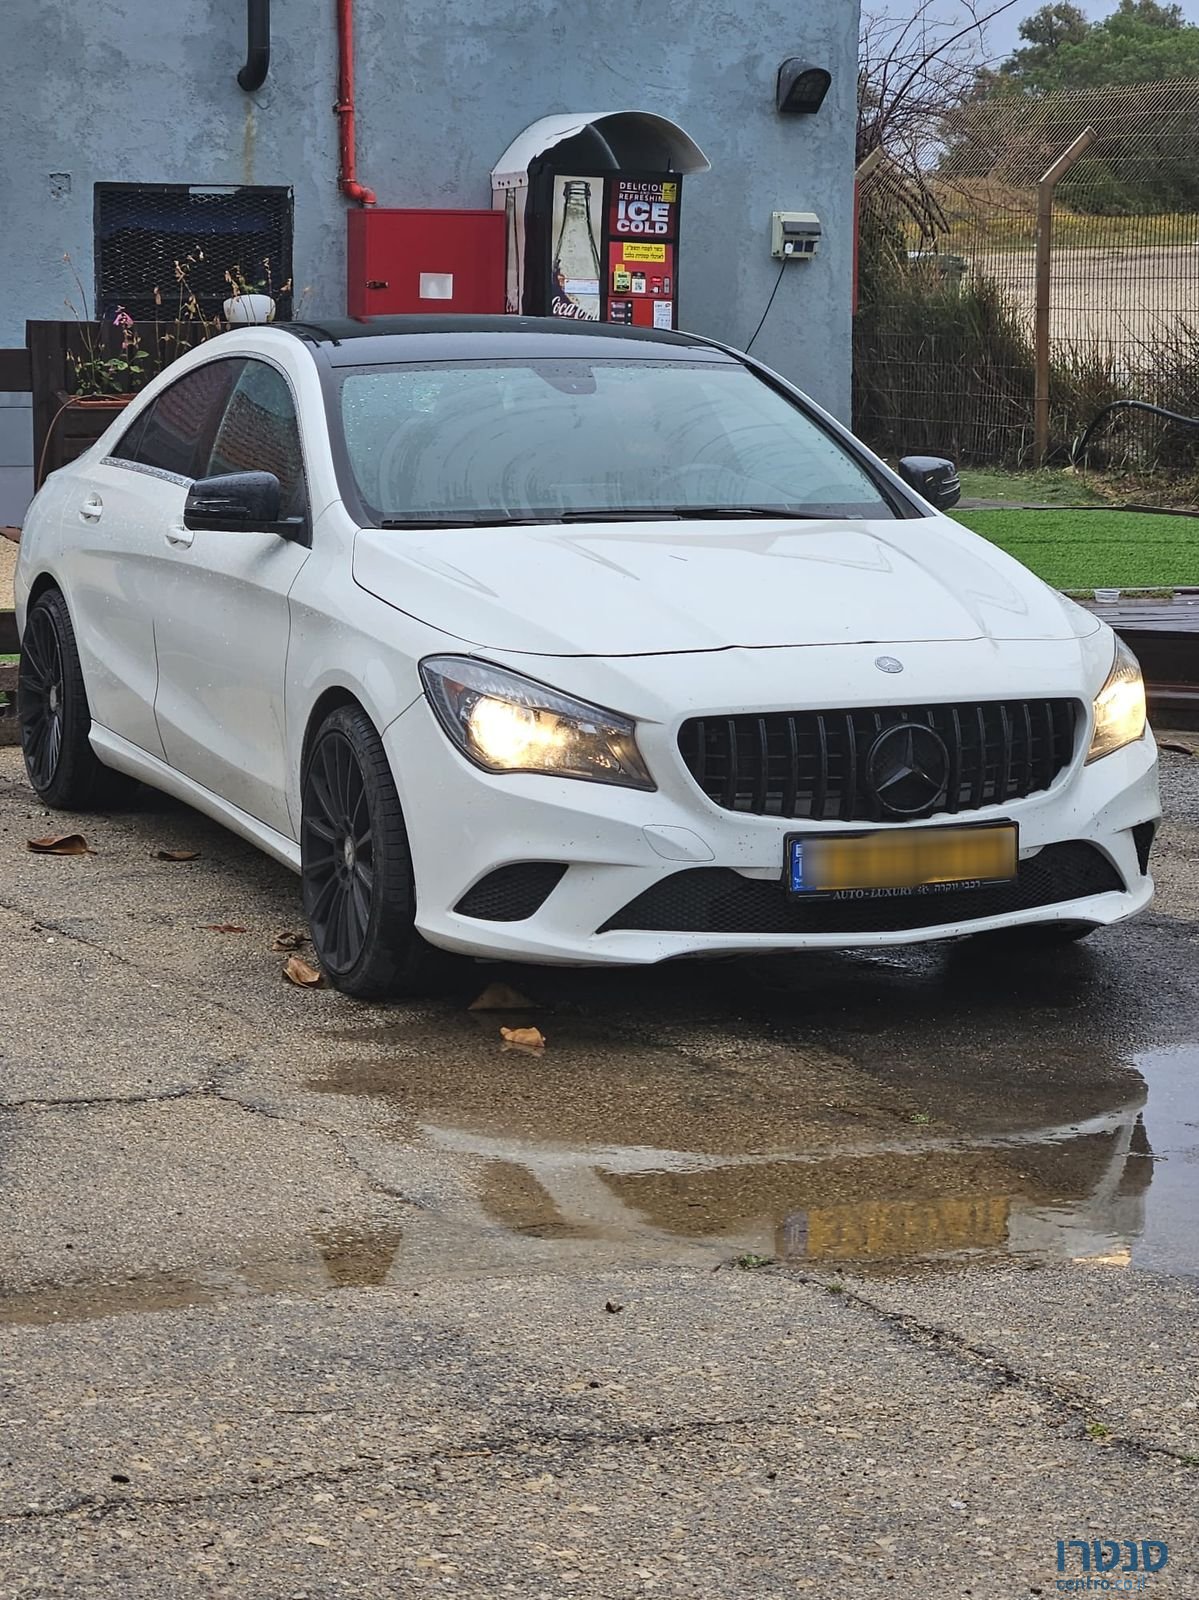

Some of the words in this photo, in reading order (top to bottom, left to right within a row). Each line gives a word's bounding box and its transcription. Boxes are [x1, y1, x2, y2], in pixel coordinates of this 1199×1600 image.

[619, 181, 664, 192] DELICIOU
[618, 193, 664, 202] REFRESHIN
[618, 200, 670, 222] ICE
[616, 219, 668, 234] COLD
[960, 880, 981, 889] רכבי
[833, 886, 914, 900] AUTO-LUXURY
